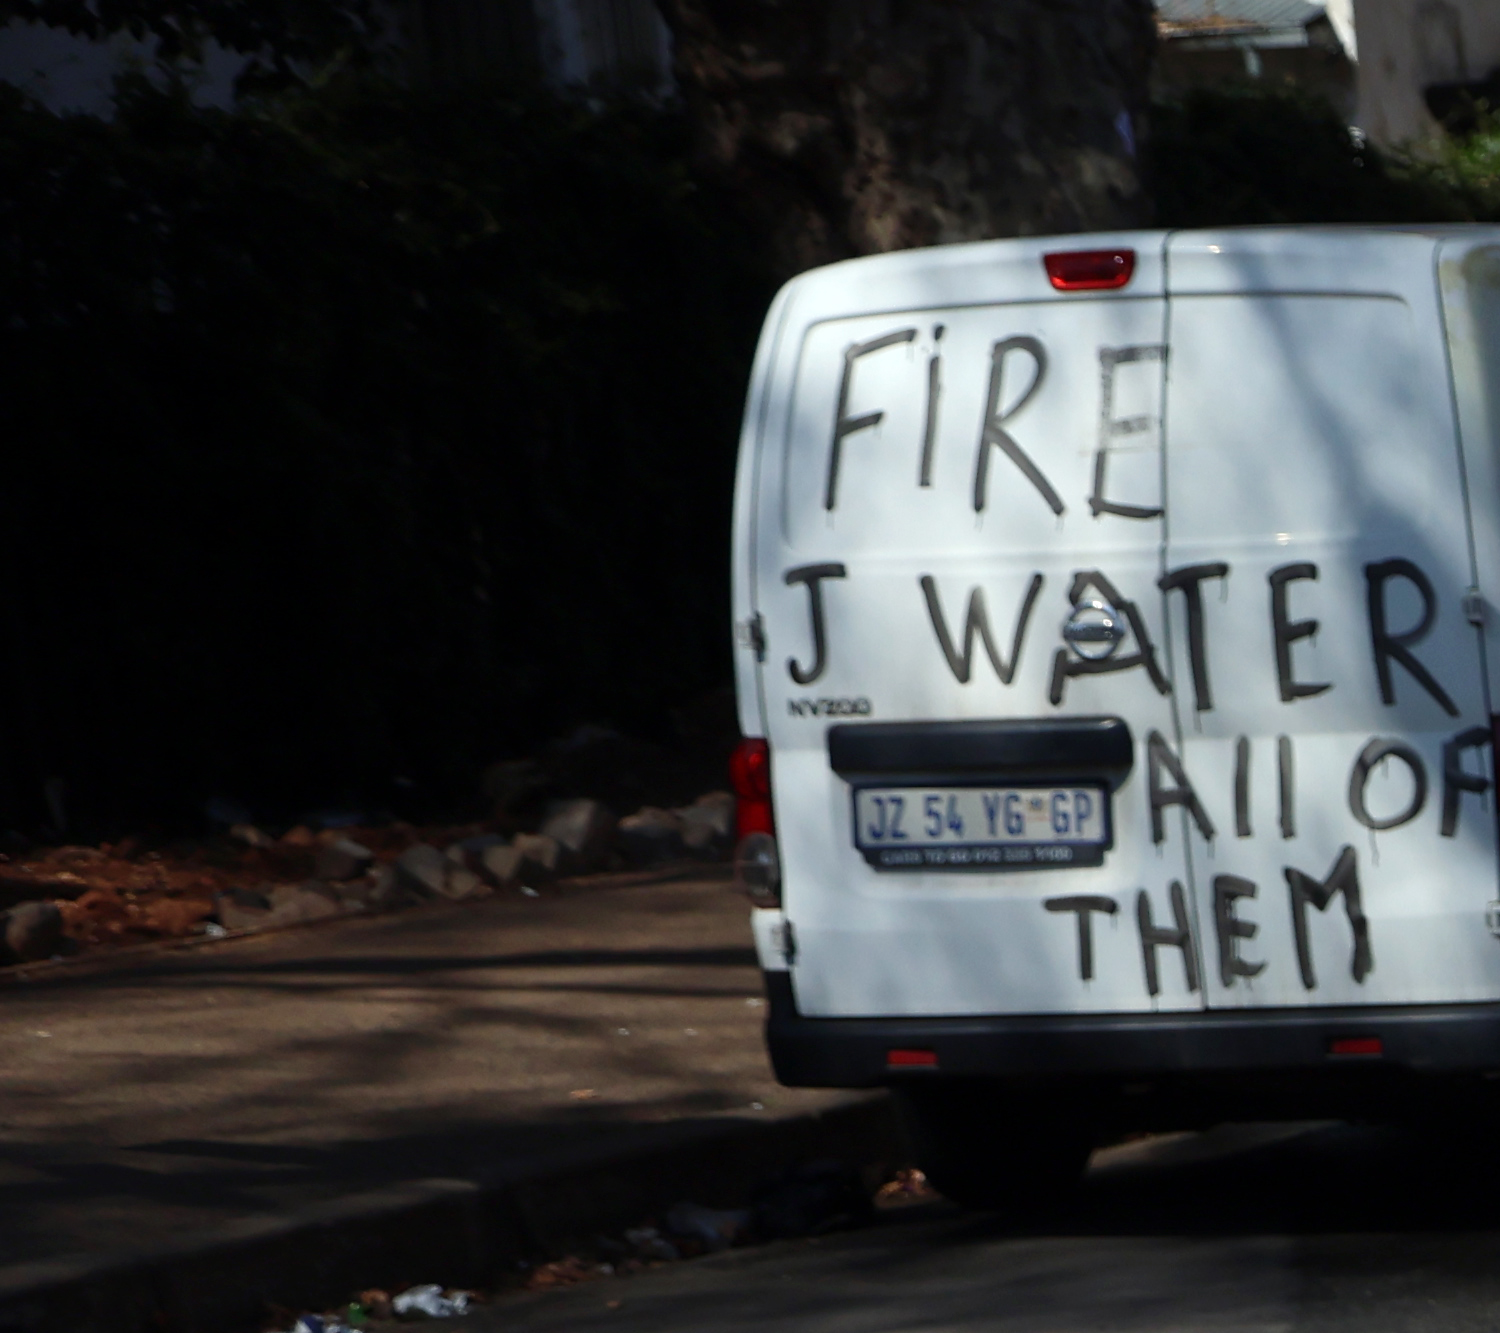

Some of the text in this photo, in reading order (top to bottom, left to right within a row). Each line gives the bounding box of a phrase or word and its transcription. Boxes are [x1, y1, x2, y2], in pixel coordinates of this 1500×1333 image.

[784, 559, 1459, 717] J WATER
[868, 788, 1093, 840] JZ 54 YG GP
[1348, 726, 1493, 837] OF
[1045, 846, 1375, 997] THEM
